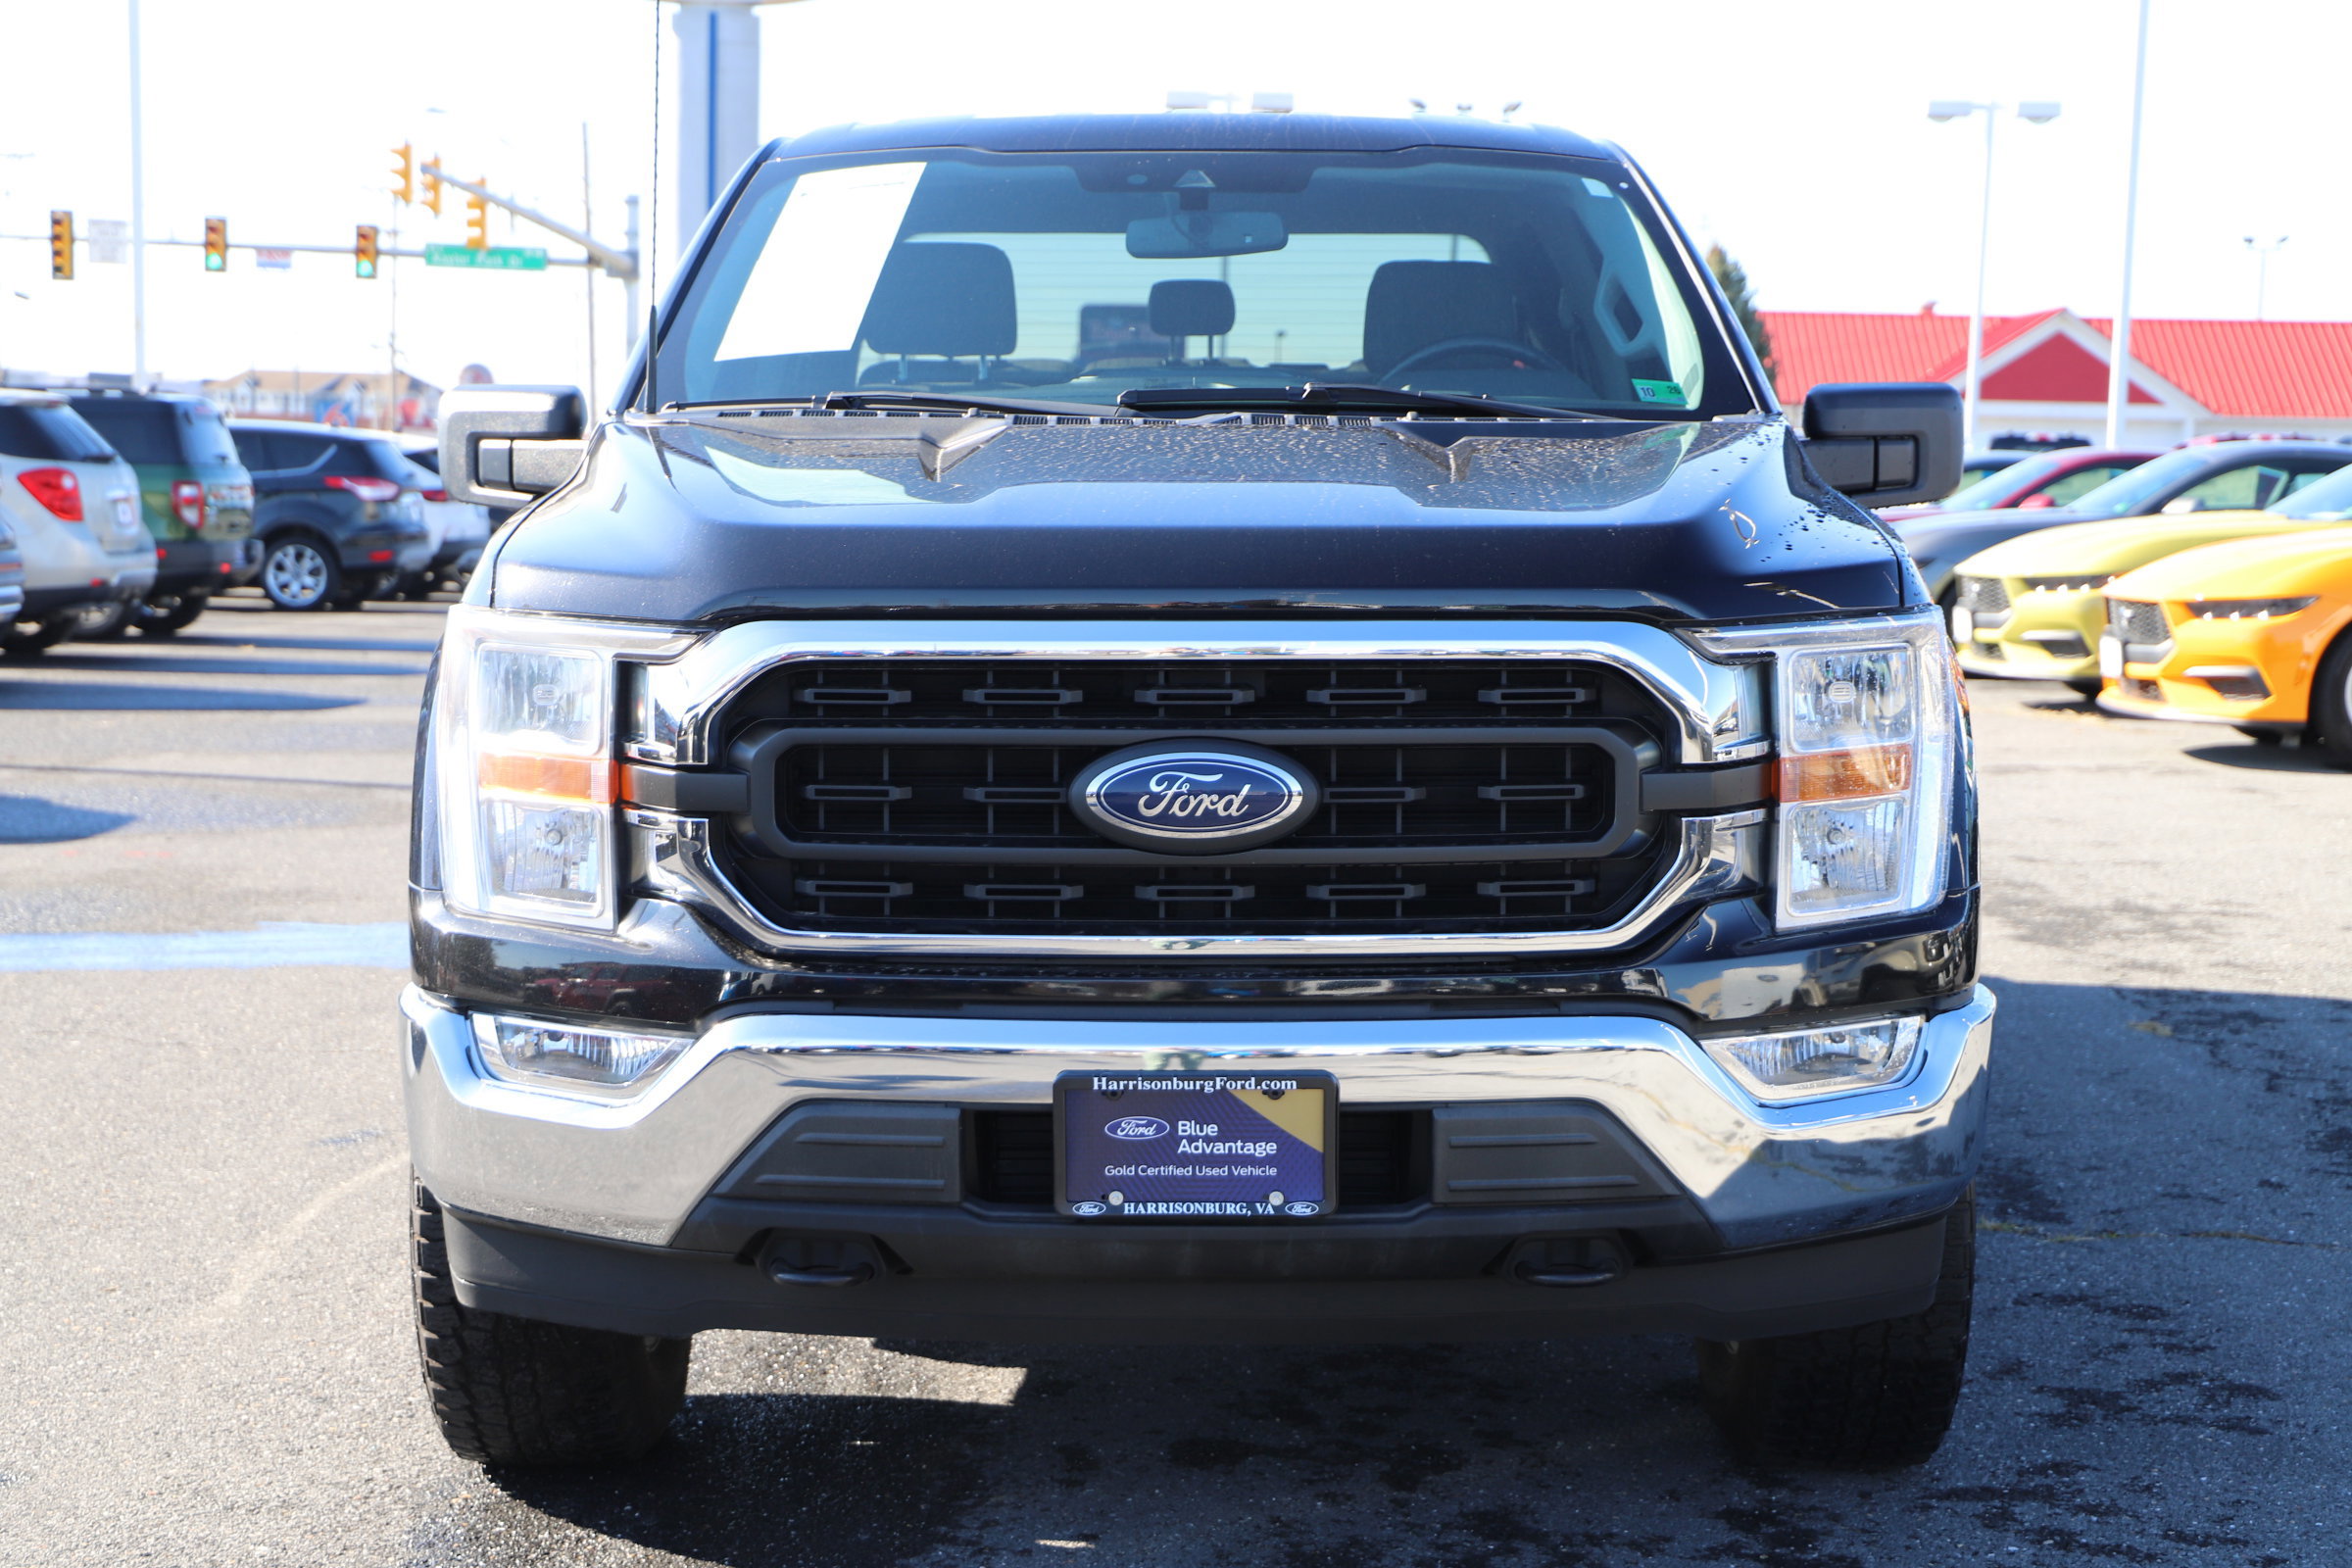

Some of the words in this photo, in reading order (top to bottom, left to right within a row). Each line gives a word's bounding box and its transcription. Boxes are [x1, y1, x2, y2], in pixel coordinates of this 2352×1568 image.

[1640, 386, 1655, 398] 10
[1138, 770, 1251, 817] Ford
[1093, 1076, 1298, 1093] HarrisonburgFord.com
[1117, 1119, 1157, 1137] Ford
[1177, 1120, 1218, 1137] Blue
[1177, 1139, 1278, 1157] Advantage
[1104, 1164, 1135, 1177] Gold
[1138, 1164, 1193, 1177] Certified
[1196, 1164, 1228, 1177] Used
[1231, 1164, 1277, 1177] Vehicle
[1079, 1203, 1100, 1214] Ford
[1123, 1201, 1251, 1217] HARRISONBURG,
[1255, 1202, 1275, 1215] VA
[1291, 1203, 1312, 1214] Ford
